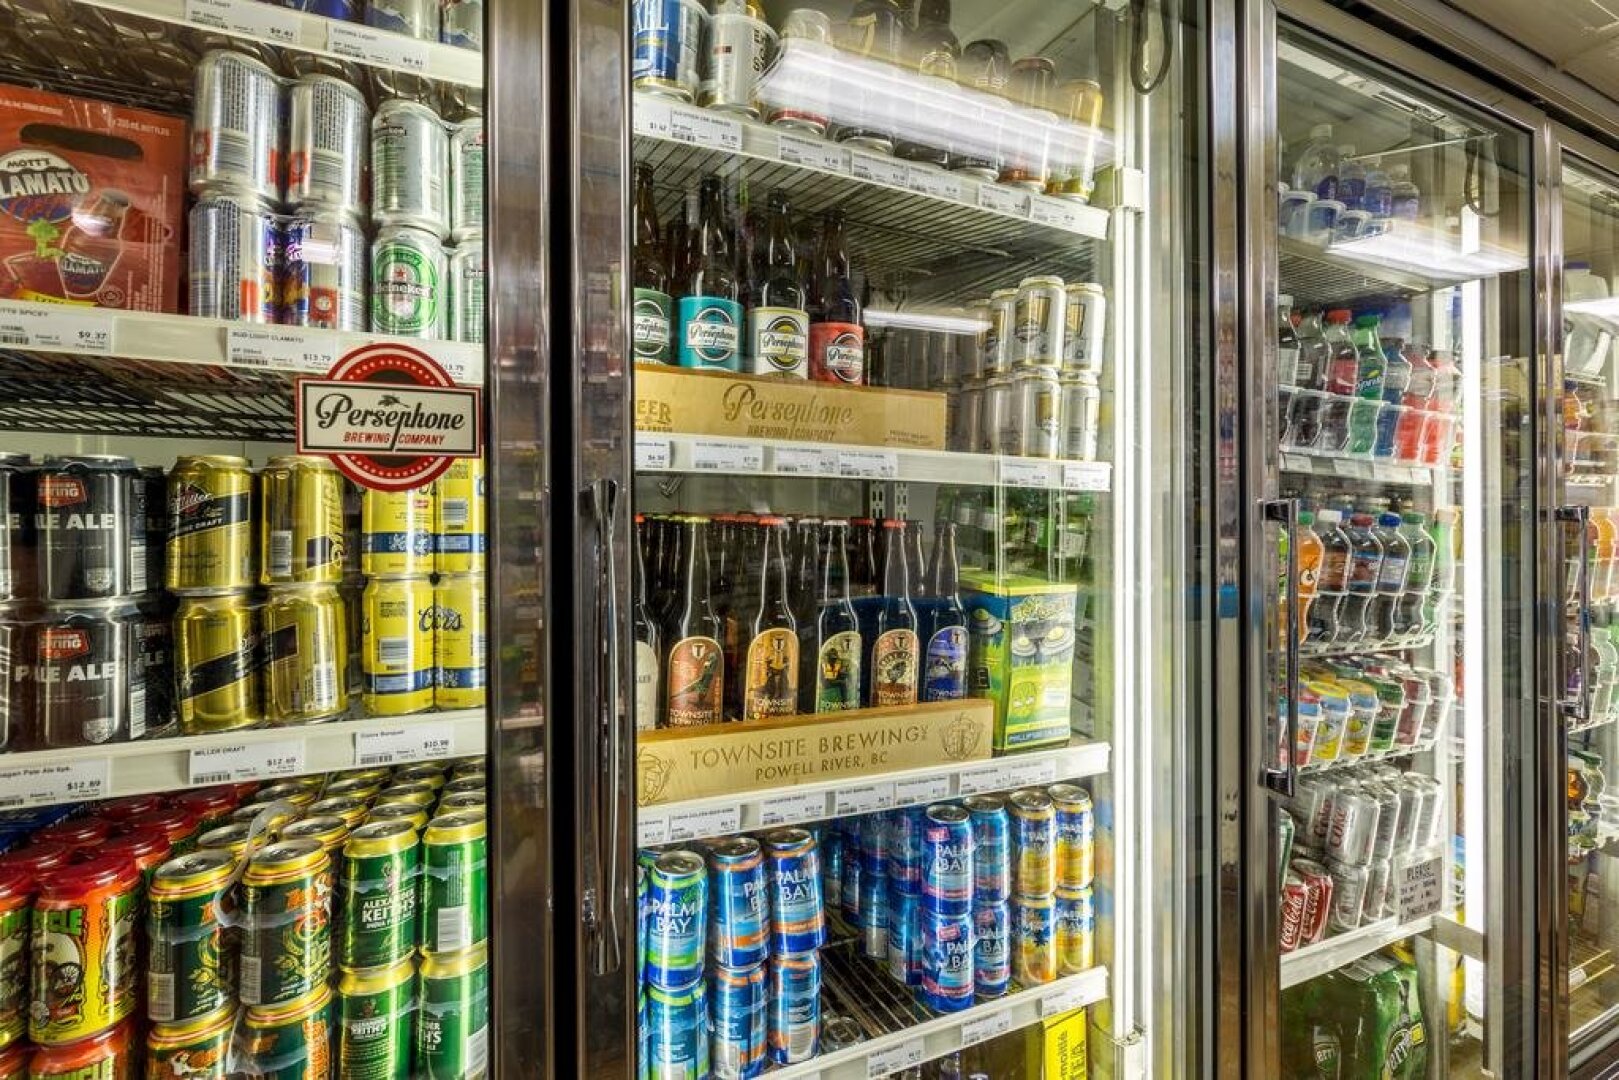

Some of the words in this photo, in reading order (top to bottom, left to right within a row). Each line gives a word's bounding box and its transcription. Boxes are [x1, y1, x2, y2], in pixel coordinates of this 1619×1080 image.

[721, 382, 854, 425] Persephone
[315, 392, 466, 440] Persephone
[343, 431, 391, 445] BREWING
[397, 432, 446, 446] COMPANY
[66, 513, 116, 530] ALE
[66, 661, 117, 682] ALE
[690, 738, 807, 771] TOWNSITE
[818, 724, 921, 753] BREWING
[755, 762, 815, 782] POWELL
[820, 753, 865, 772] RIVER,
[870, 750, 888, 765] BC
[782, 884, 813, 901] BAY
[651, 897, 695, 917] PALM
[655, 916, 692, 934] BAY
